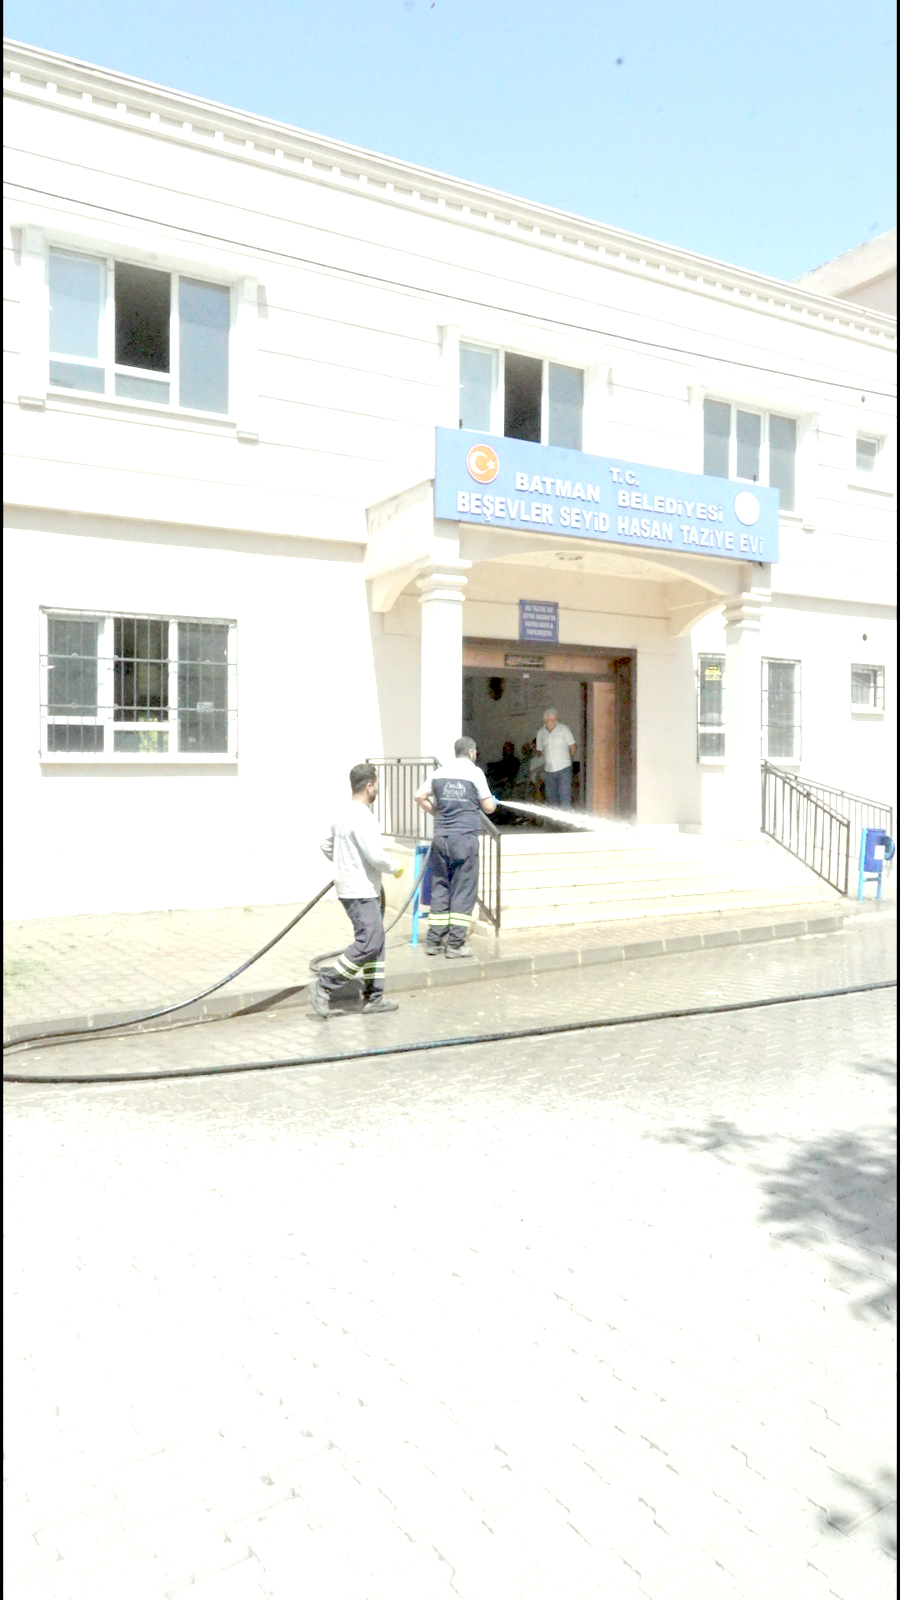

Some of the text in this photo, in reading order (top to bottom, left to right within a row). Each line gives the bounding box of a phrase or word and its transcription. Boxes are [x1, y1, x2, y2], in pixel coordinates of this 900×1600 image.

[515, 471, 600, 503] BATMAN
[609, 466, 640, 487] T.C.
[456, 490, 553, 525] BEŞEVLER
[617, 514, 673, 542] HASAN
